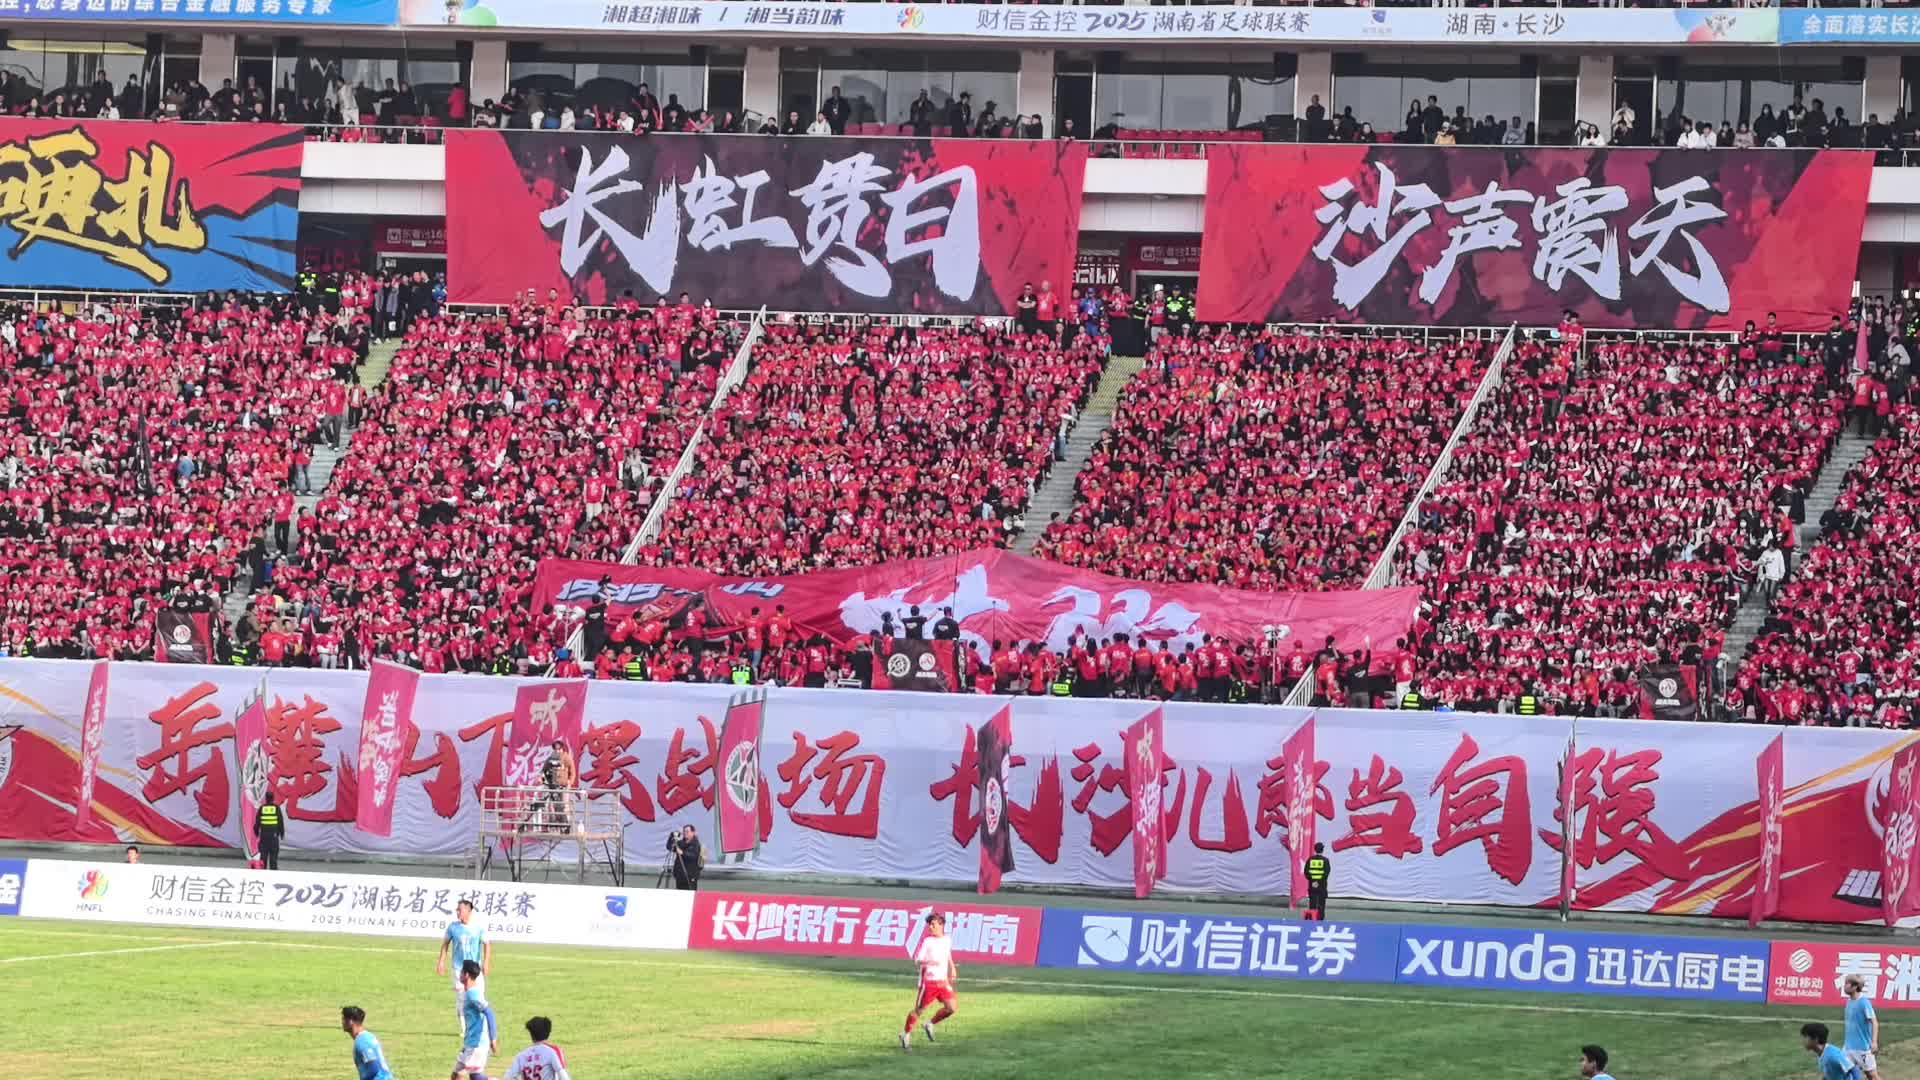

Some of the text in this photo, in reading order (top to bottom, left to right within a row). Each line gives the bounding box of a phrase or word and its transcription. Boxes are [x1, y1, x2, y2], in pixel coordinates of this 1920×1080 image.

[602, 5, 701, 25] 湘超湘味
[745, 6, 846, 26] 湘当韵味
[976, 9, 1077, 32] 财信金控
[1446, 13, 1566, 35] 湖南·长沙
[540, 143, 981, 301] 长虹贯日
[1312, 162, 1731, 313] 沙声震天
[148, 874, 265, 905] 财信金控
[146, 906, 285, 922] CHASING FINANCIAL
[311, 914, 342, 926] 2025
[348, 917, 396, 929] HUNAN
[487, 923, 534, 935] EAGUE
[1138, 919, 1357, 977] 财信证券
[1402, 934, 1765, 993] xunda 迅达厨电
[1774, 988, 1822, 998] China Mobile
[1775, 976, 1823, 989] 中国移动
